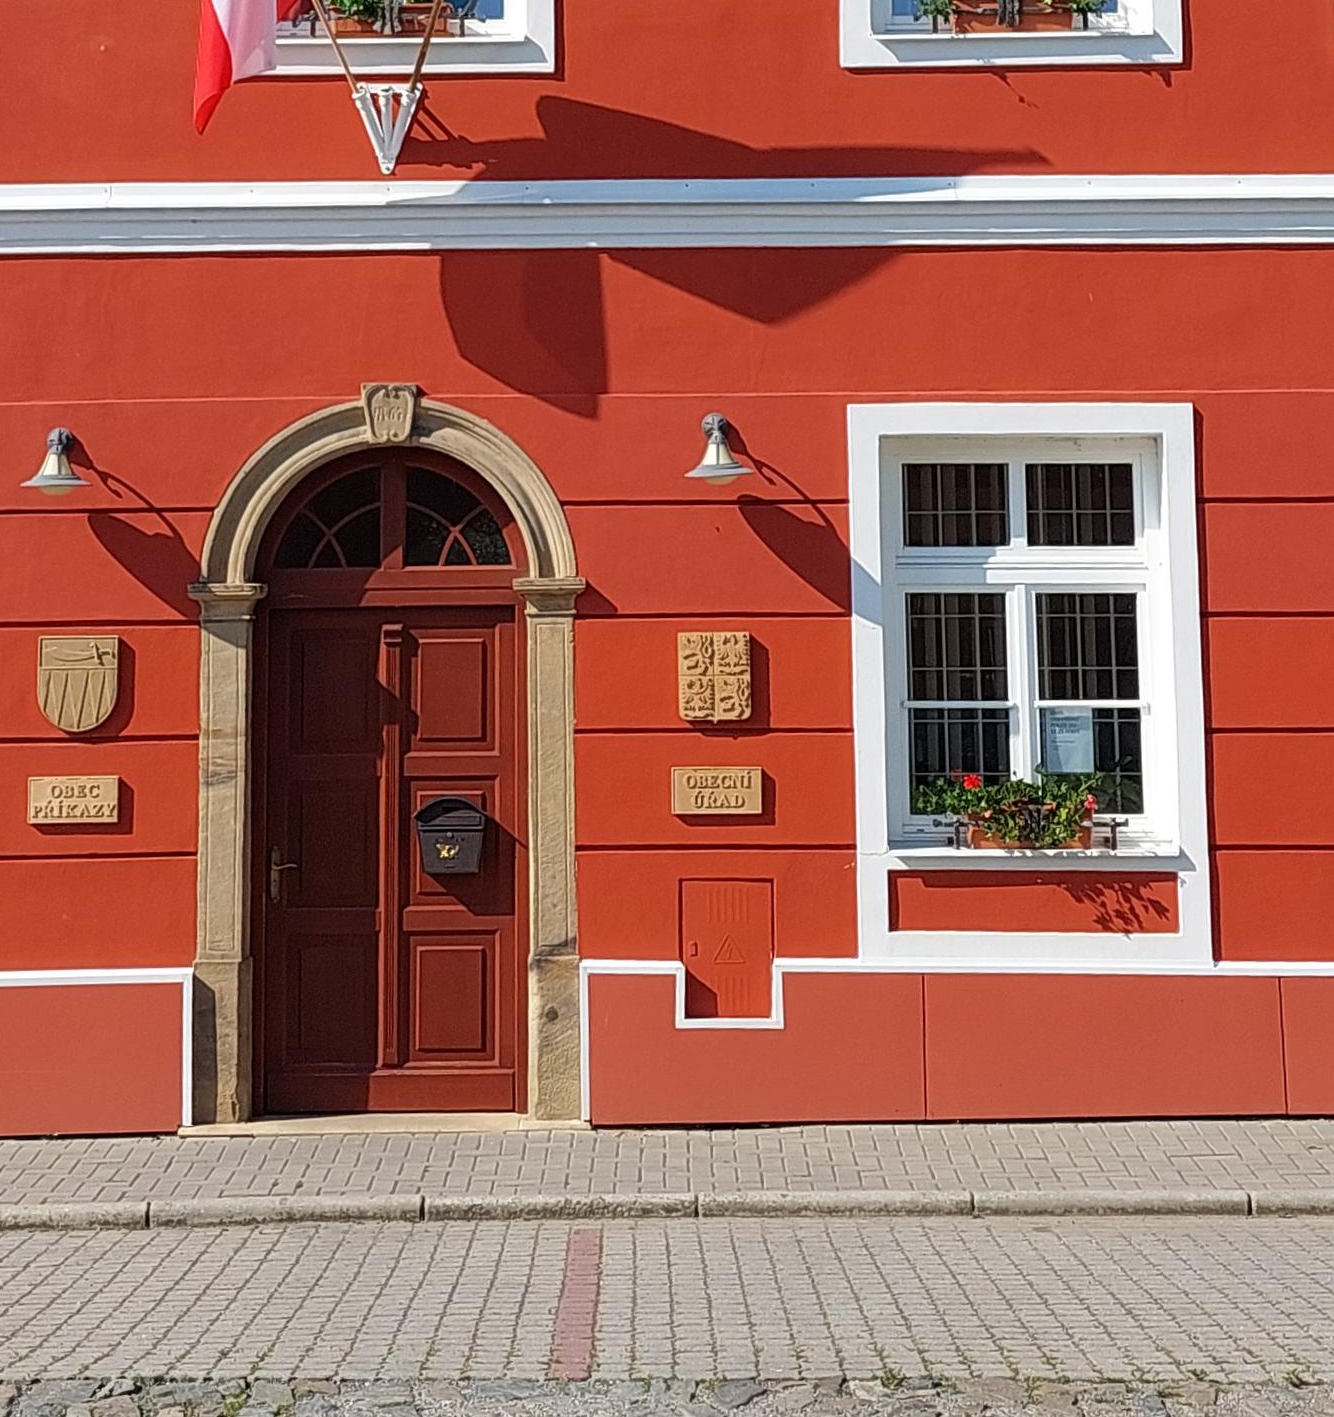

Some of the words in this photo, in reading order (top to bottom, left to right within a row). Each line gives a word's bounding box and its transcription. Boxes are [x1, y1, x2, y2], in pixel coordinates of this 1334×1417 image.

[686, 771, 753, 790] OBECNÍ
[51, 784, 101, 799] OBEC
[694, 790, 746, 809] ÚŘAD
[32, 799, 117, 819] PŘÍKAZY
